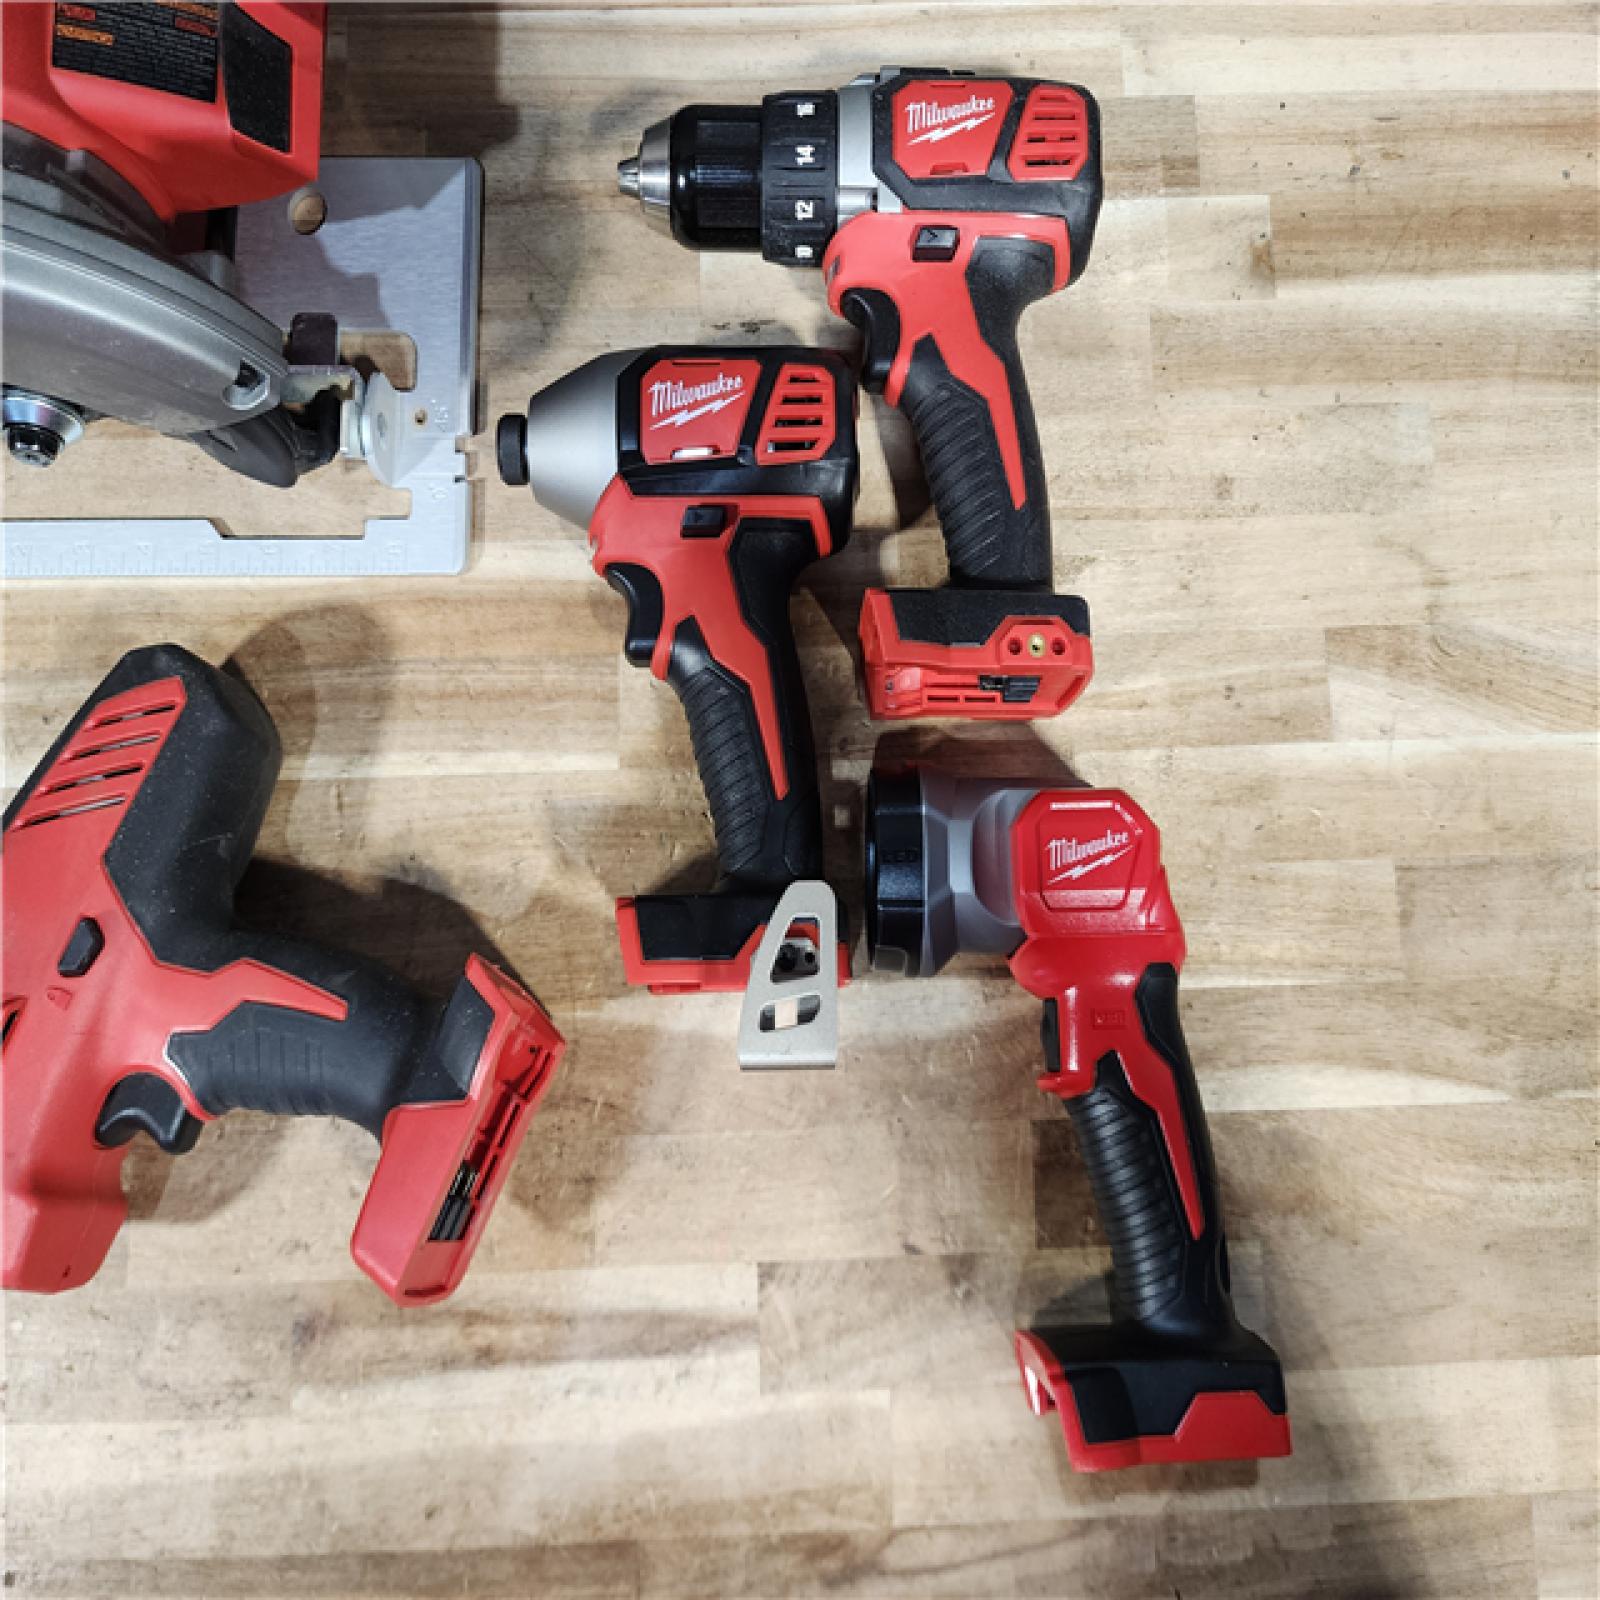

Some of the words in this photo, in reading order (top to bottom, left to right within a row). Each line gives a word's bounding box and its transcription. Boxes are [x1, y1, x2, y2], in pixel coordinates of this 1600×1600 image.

[904, 95, 995, 133] Milwaukee
[795, 144, 815, 165] 14
[795, 199, 814, 220] 12
[647, 372, 743, 417] Milwaukee
[1044, 829, 1128, 870] Milwaukee
